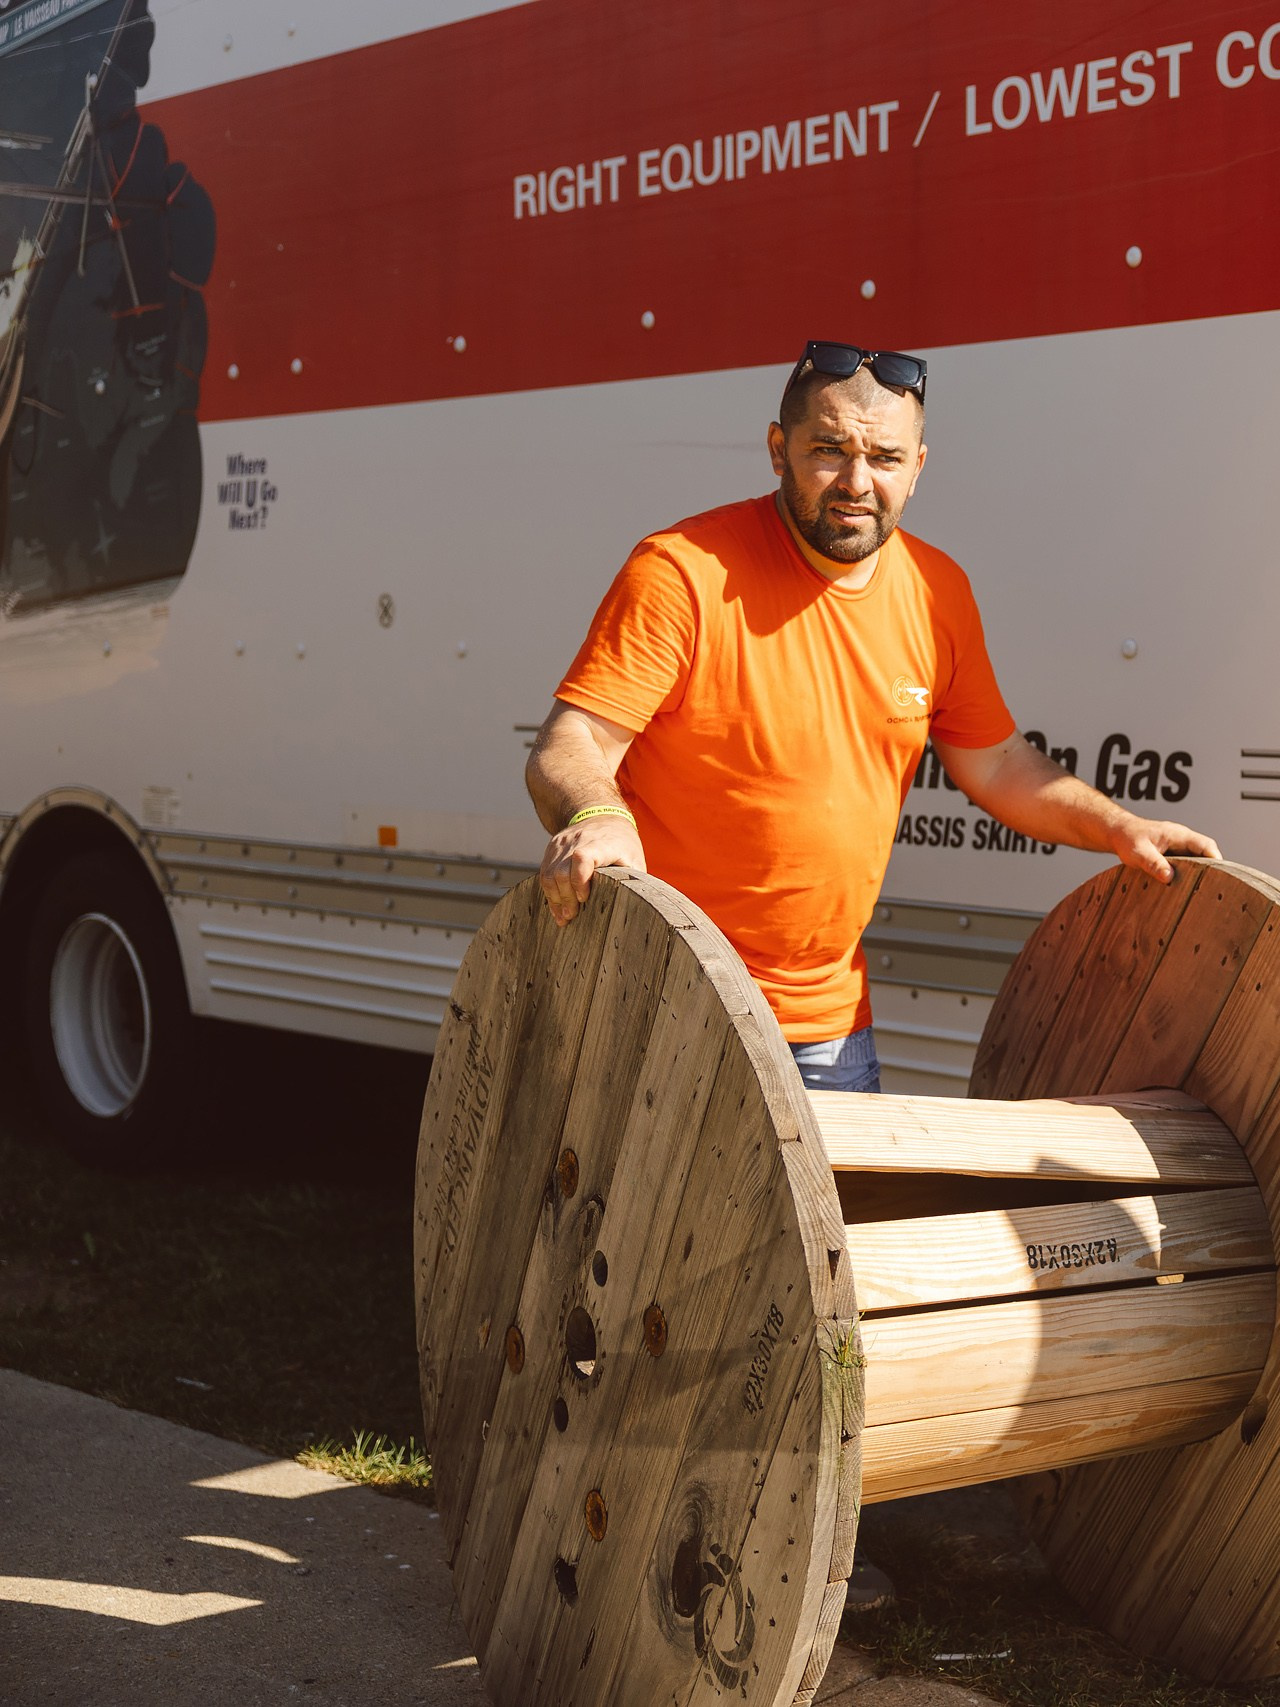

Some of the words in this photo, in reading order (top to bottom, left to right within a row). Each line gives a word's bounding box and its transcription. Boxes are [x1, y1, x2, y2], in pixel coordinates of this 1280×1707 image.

[513, 155, 628, 220] RIGHT
[637, 101, 900, 198] EQUIPMENT
[913, 90, 941, 148] /
[965, 41, 1194, 137] LOWEST
[226, 453, 267, 475] Where
[218, 481, 242, 504] Will
[245, 479, 258, 509] U
[261, 480, 278, 502] Go
[229, 505, 267, 530] Next?
[1095, 733, 1193, 803] Gas
[894, 814, 967, 848] ASSIS
